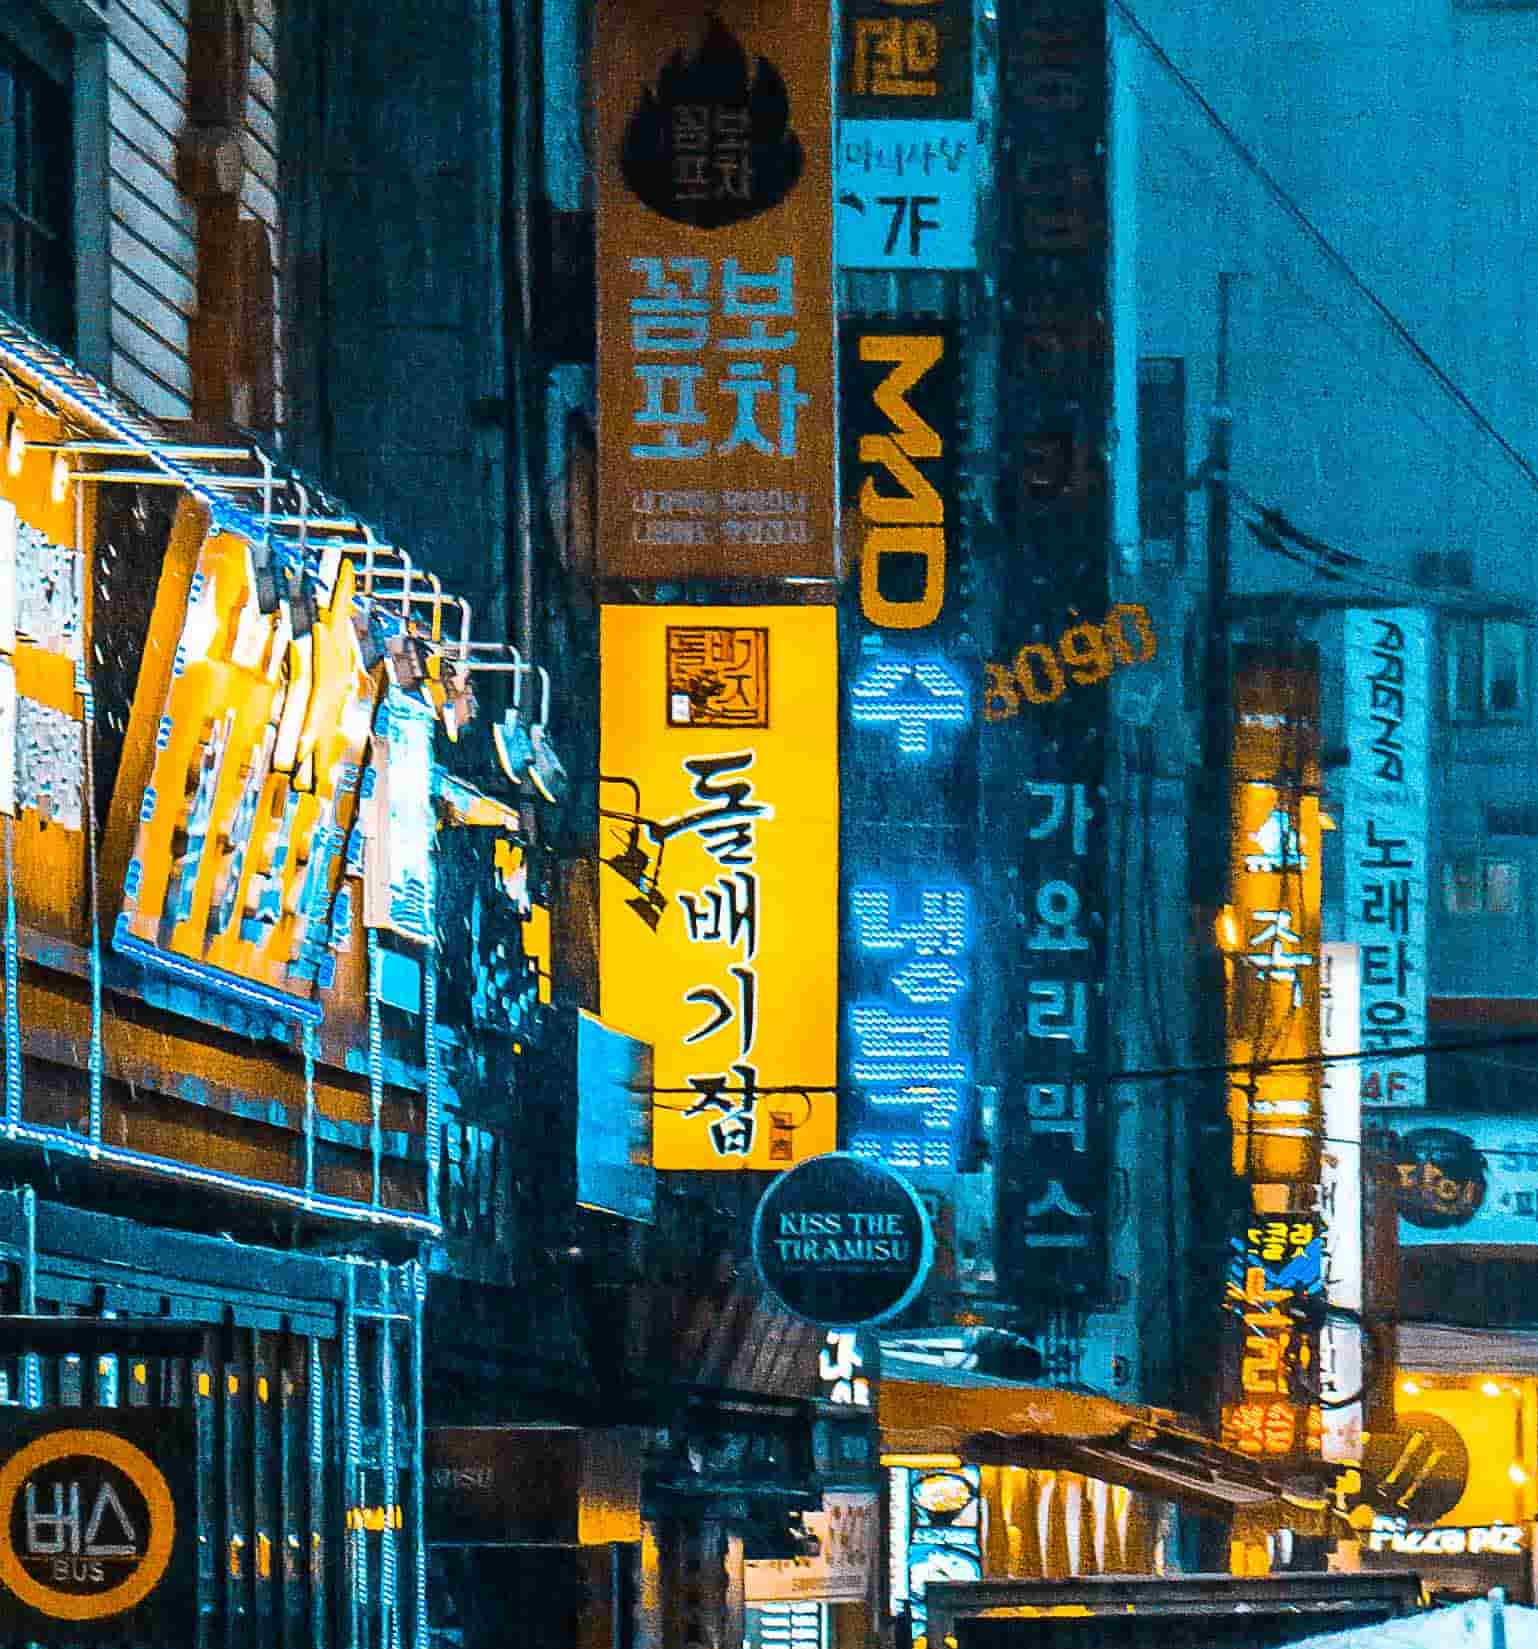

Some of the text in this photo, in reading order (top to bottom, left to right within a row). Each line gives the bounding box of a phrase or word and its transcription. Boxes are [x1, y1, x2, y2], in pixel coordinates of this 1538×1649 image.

[876, 195, 940, 257] 7F
[628, 361, 813, 459] 포차
[983, 603, 1157, 722] 8090
[773, 1239, 911, 1262] TIRAMISU
[778, 1212, 905, 1236] KISS THE
[25, 1481, 138, 1555] 버스
[50, 1558, 105, 1582] BUS
